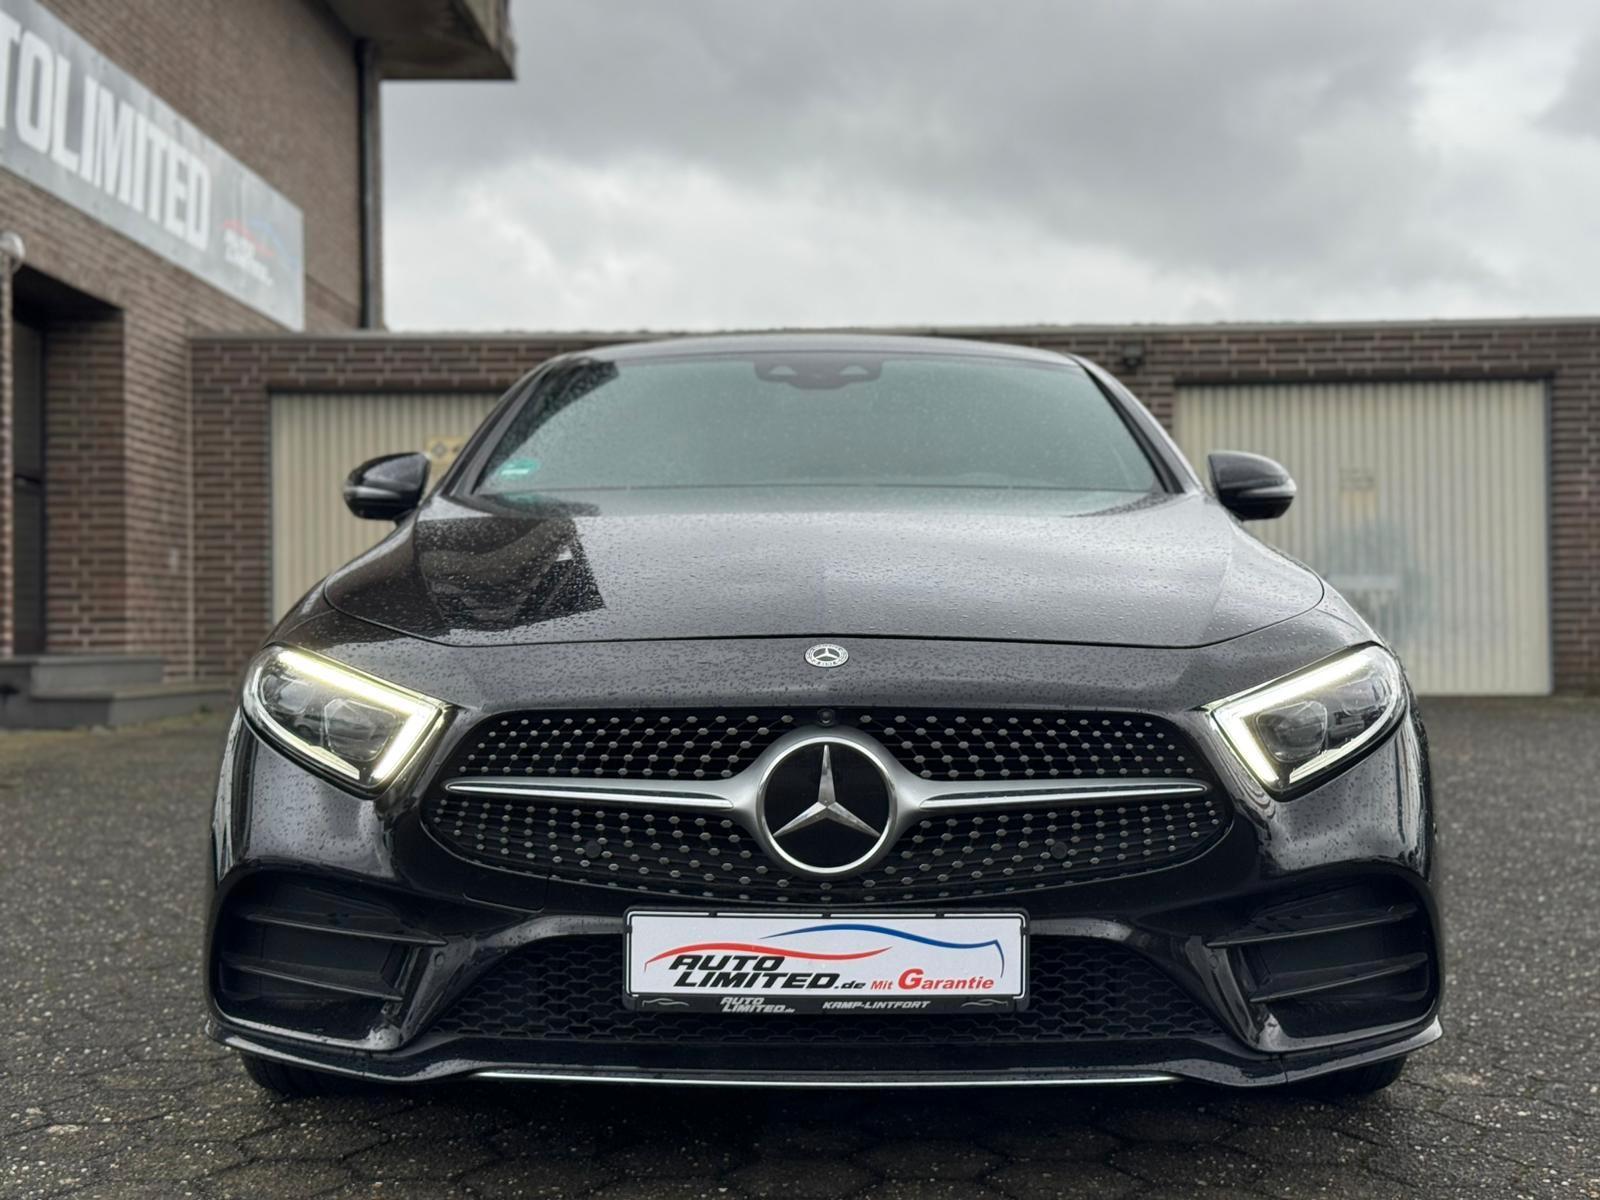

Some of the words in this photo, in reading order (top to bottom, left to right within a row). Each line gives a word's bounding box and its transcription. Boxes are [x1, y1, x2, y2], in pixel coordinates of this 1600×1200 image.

[668, 954, 786, 971] AUTO
[673, 972, 867, 990] LIMITED.de
[870, 980, 894, 990] Mit
[898, 968, 994, 990] Garantie
[719, 997, 765, 1005] AUTO
[822, 1000, 932, 1010] KAMP-LINTFORT
